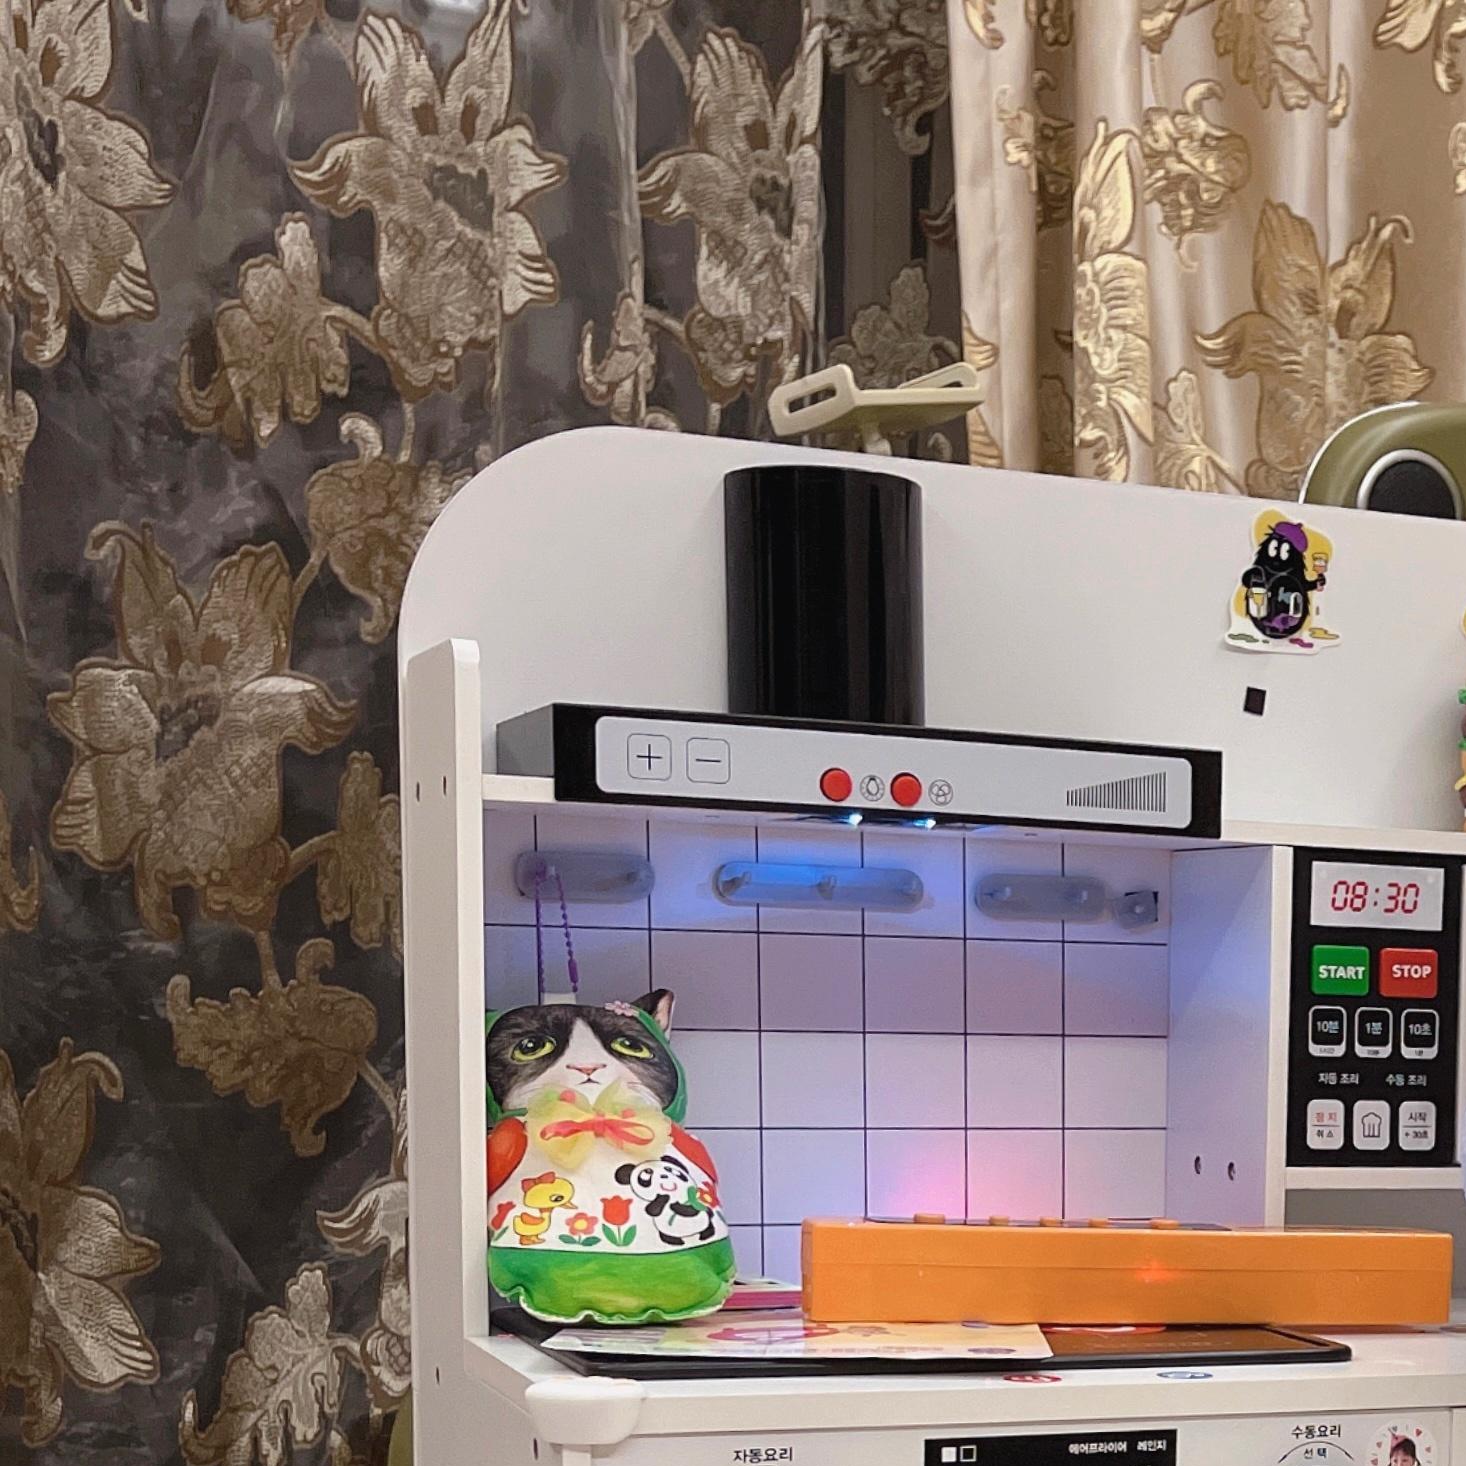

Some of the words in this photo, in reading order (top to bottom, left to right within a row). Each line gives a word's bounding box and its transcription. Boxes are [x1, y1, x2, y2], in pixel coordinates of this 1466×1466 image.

[1331, 880, 1420, 914] 08:30
[1318, 964, 1366, 980] START
[1391, 964, 1432, 979] STOP
[1316, 1020, 1340, 1034] 10분
[1365, 1021, 1383, 1035] 1분
[1408, 1022, 1433, 1036] 10초
[1291, 1424, 1341, 1440] 수동요리
[733, 1446, 793, 1464] 자동요리
[1068, 1441, 1127, 1455] 에어프라이어
[1137, 1439, 1167, 1452] 레인지
